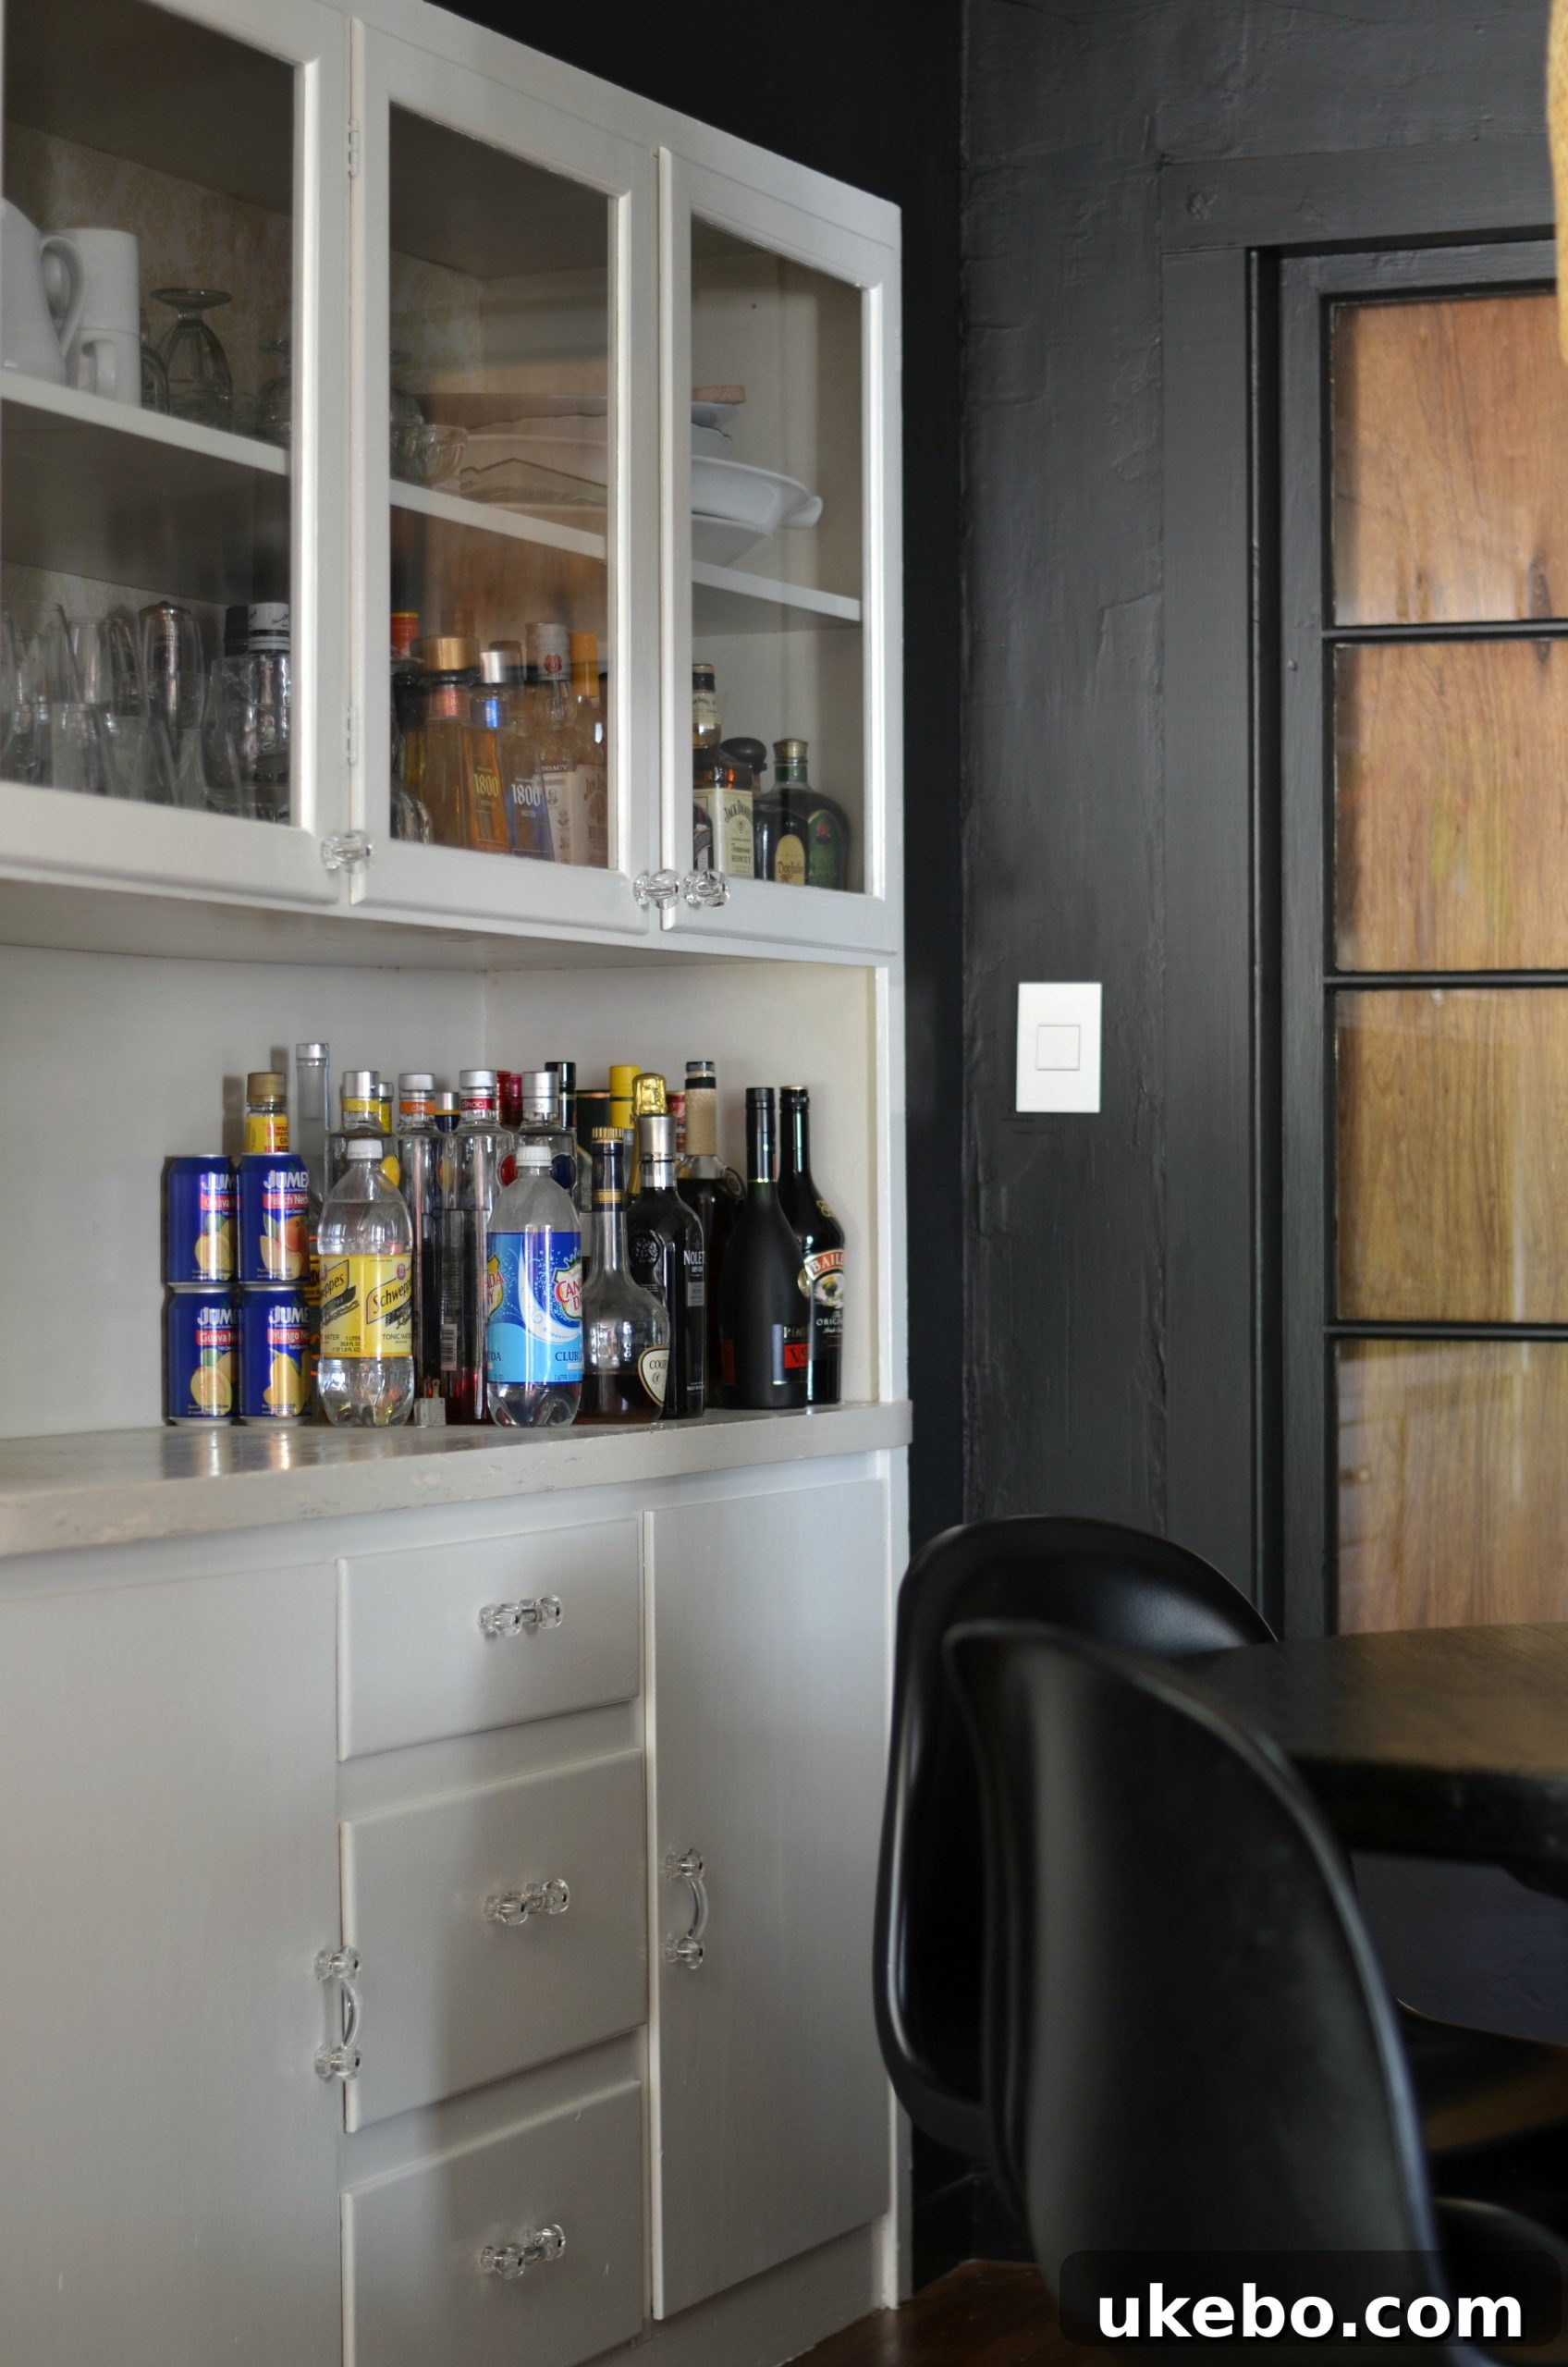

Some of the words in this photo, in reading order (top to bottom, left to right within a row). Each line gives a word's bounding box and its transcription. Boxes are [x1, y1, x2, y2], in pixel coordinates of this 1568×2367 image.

[474, 773, 499, 797] 1800
[511, 783, 541, 806] 1800
[268, 1306, 309, 1325] JUME
[555, 1351, 579, 1362] CLUB
